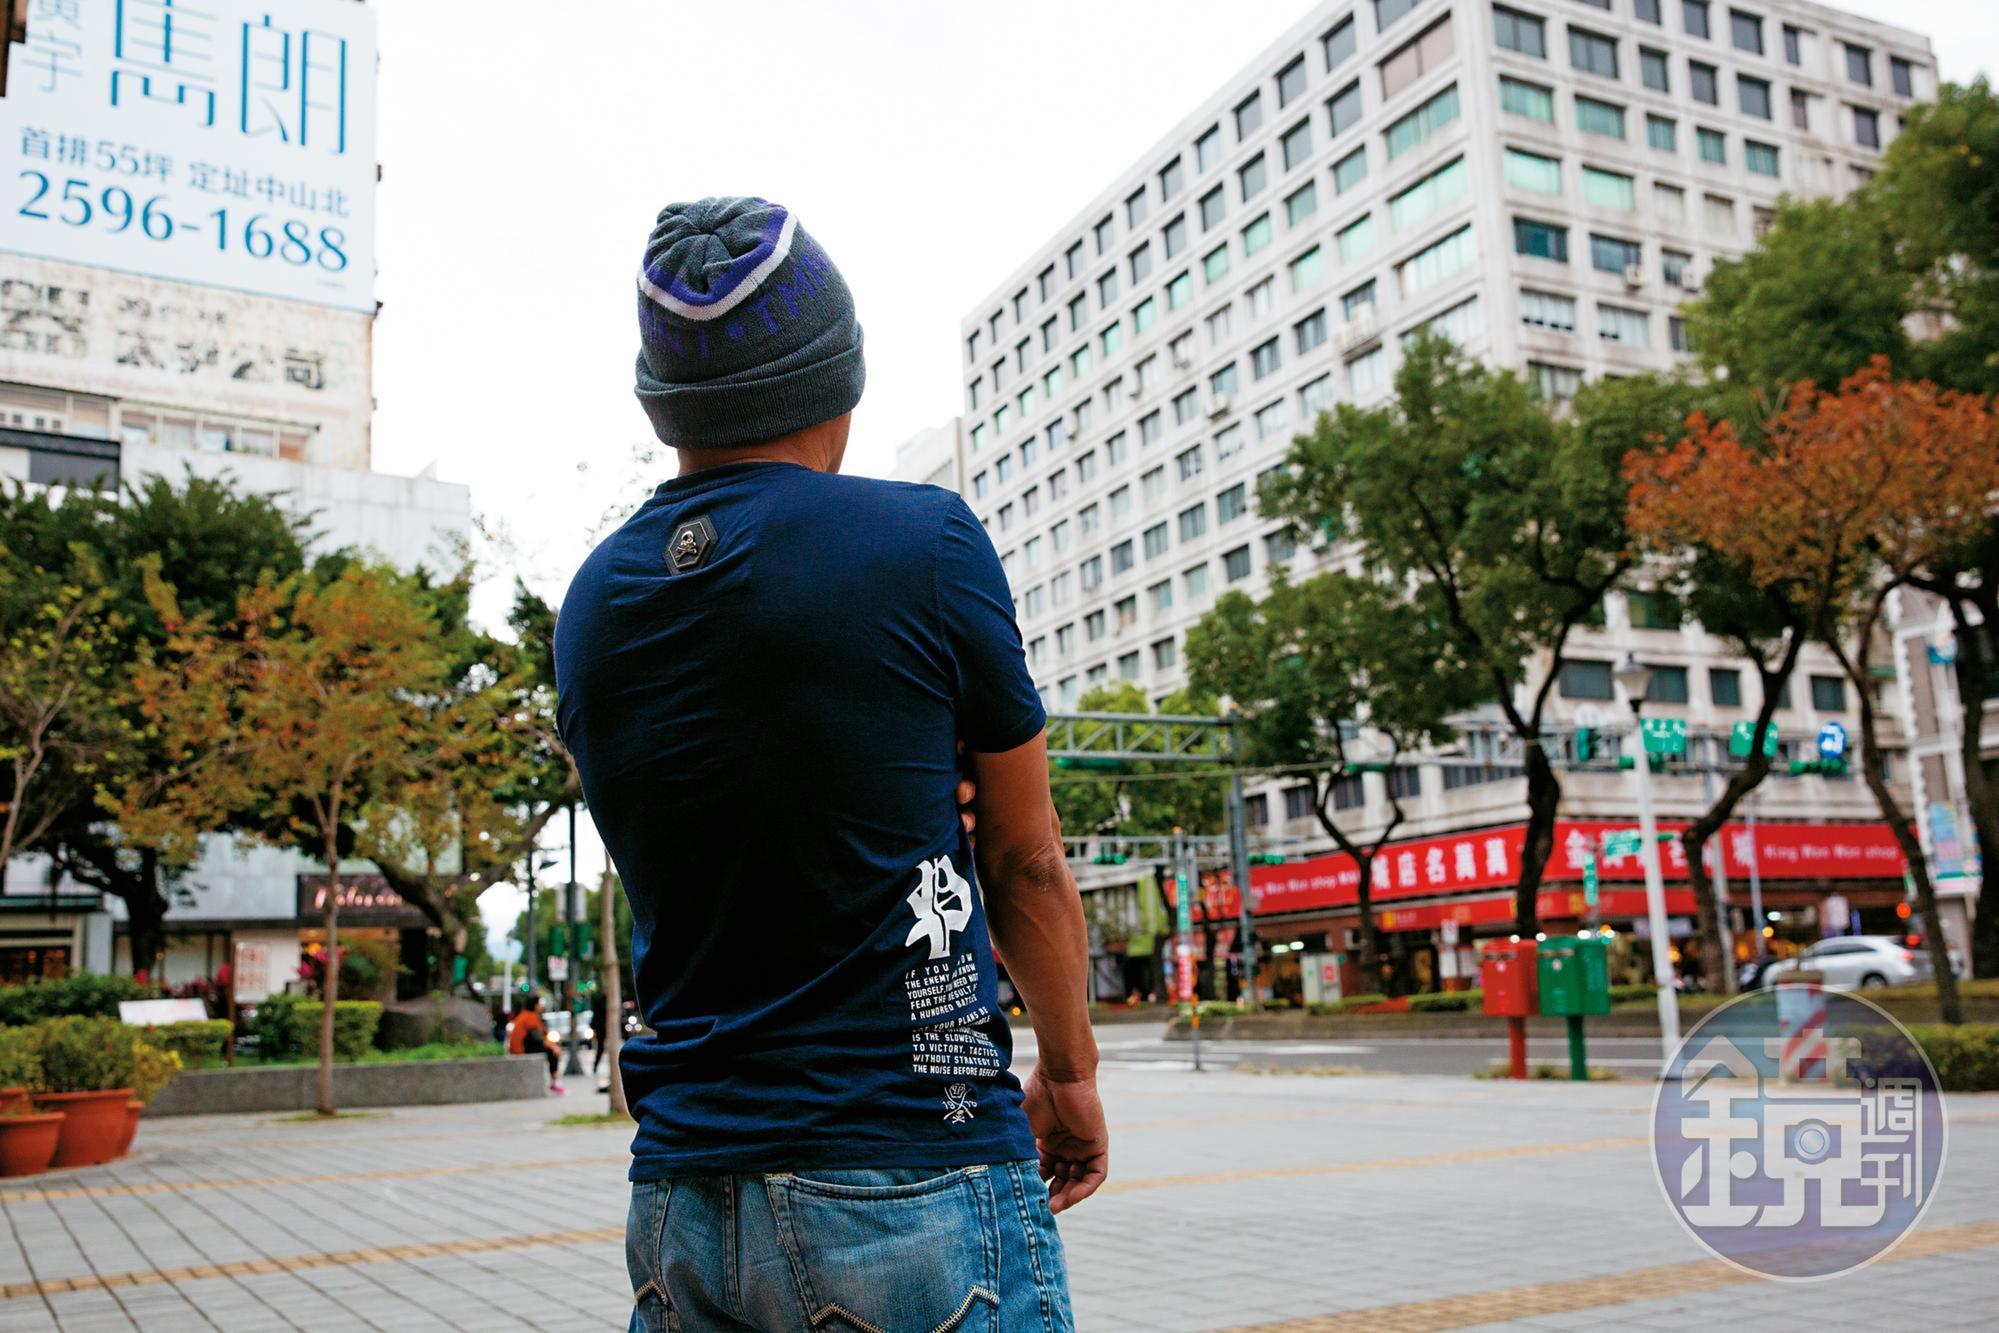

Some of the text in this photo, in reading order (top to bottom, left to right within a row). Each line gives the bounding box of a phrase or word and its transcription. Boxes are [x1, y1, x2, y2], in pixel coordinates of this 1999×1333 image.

[190, 160, 350, 218] 定址中山北
[18, 168, 348, 273] 2596-1688
[905, 969, 916, 980] IF
[924, 963, 949, 975] YOU
[905, 979, 921, 989] THE
[923, 973, 950, 986] ENEMY
[958, 962, 976, 975] KNOW
[911, 998, 932, 1010] FEAR
[934, 995, 947, 1005] THE
[911, 1011, 917, 1021] A
[920, 1003, 954, 1020] HUNDRED
[958, 1010, 979, 1026] PLANS
[979, 1005, 989, 1016] BE
[912, 1033, 921, 1042] IS
[924, 1032, 940, 1041] THE
[944, 1033, 976, 1044] SLOWEST
[912, 1043, 999, 1057] TO VICTORY. TACTICS
[912, 1054, 1000, 1067] WITHOUT STRATEGY IS
[912, 1064, 999, 1077] THE NOISE BEFORE DEFEAT
